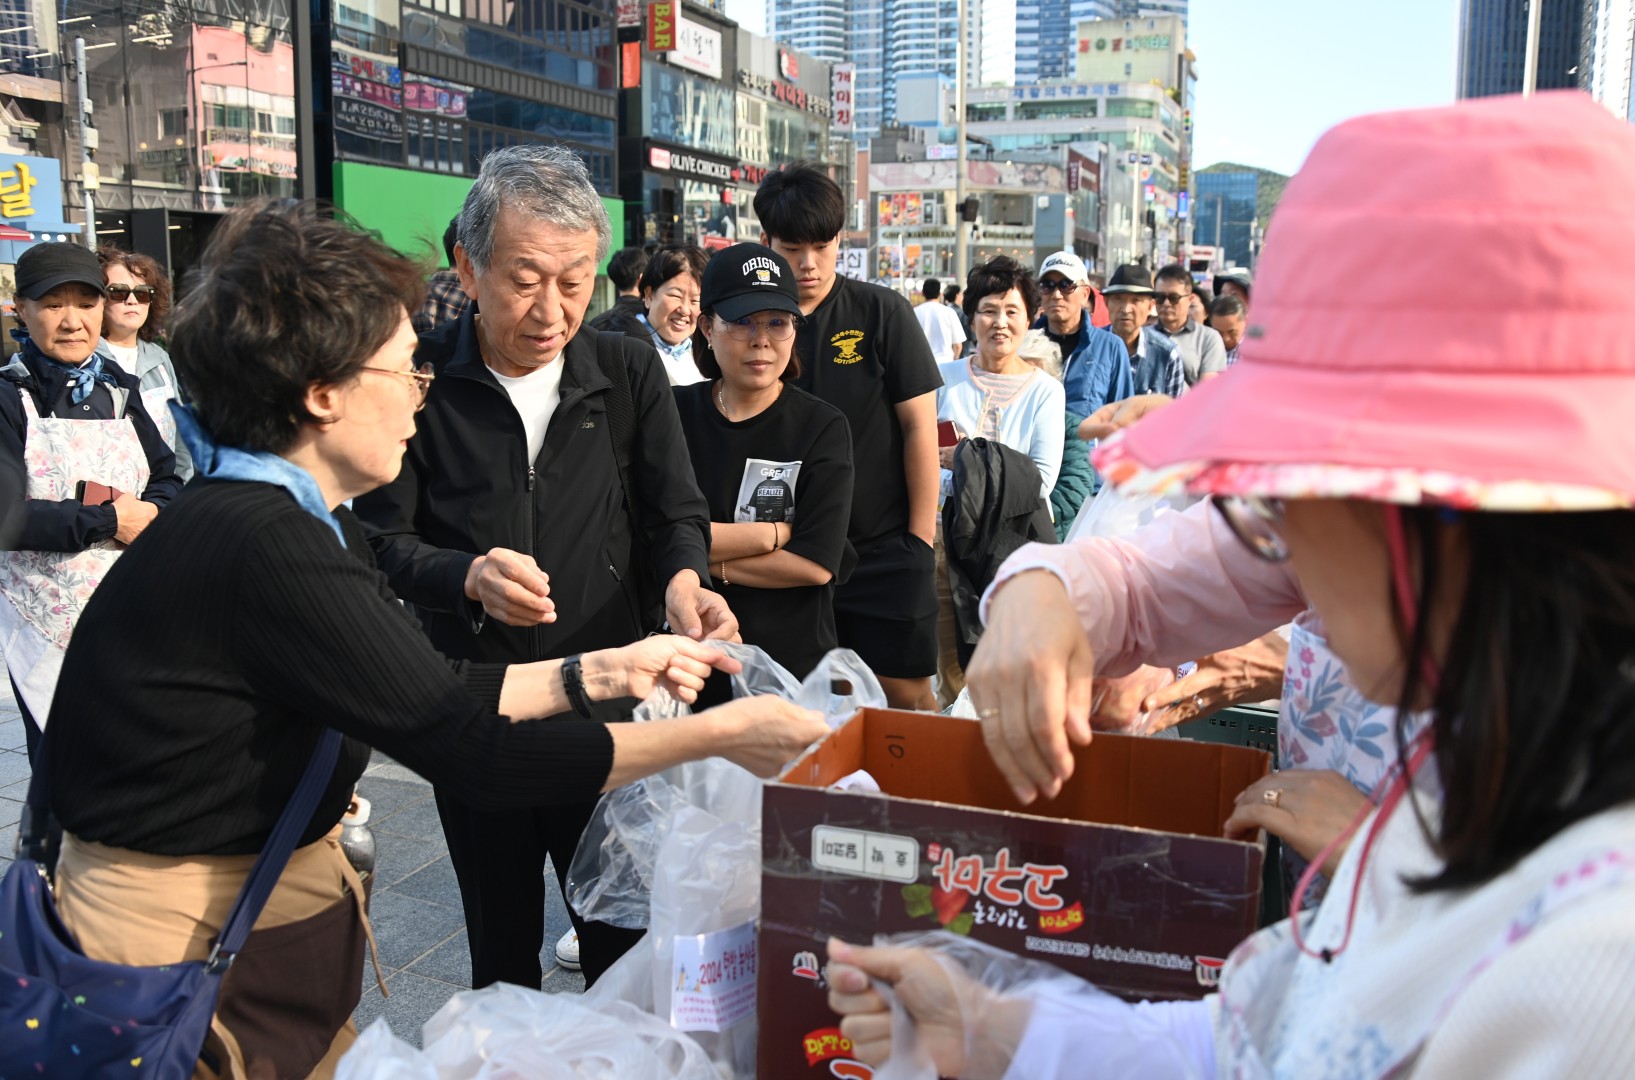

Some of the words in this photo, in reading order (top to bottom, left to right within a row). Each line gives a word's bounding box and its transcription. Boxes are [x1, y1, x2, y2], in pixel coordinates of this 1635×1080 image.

[655, 3, 671, 48] BAR
[772, 79, 806, 112] 개미집
[835, 71, 851, 125] 개미집
[670, 153, 697, 174] OLIVE
[696, 159, 731, 179] CHICKEN
[0, 162, 38, 218] 달
[742, 257, 781, 278] ORIGIN
[833, 354, 864, 365] UDT/SEAL
[761, 467, 793, 478] GREAT
[932, 848, 1068, 910] 고구마
[700, 960, 722, 985] 2024
